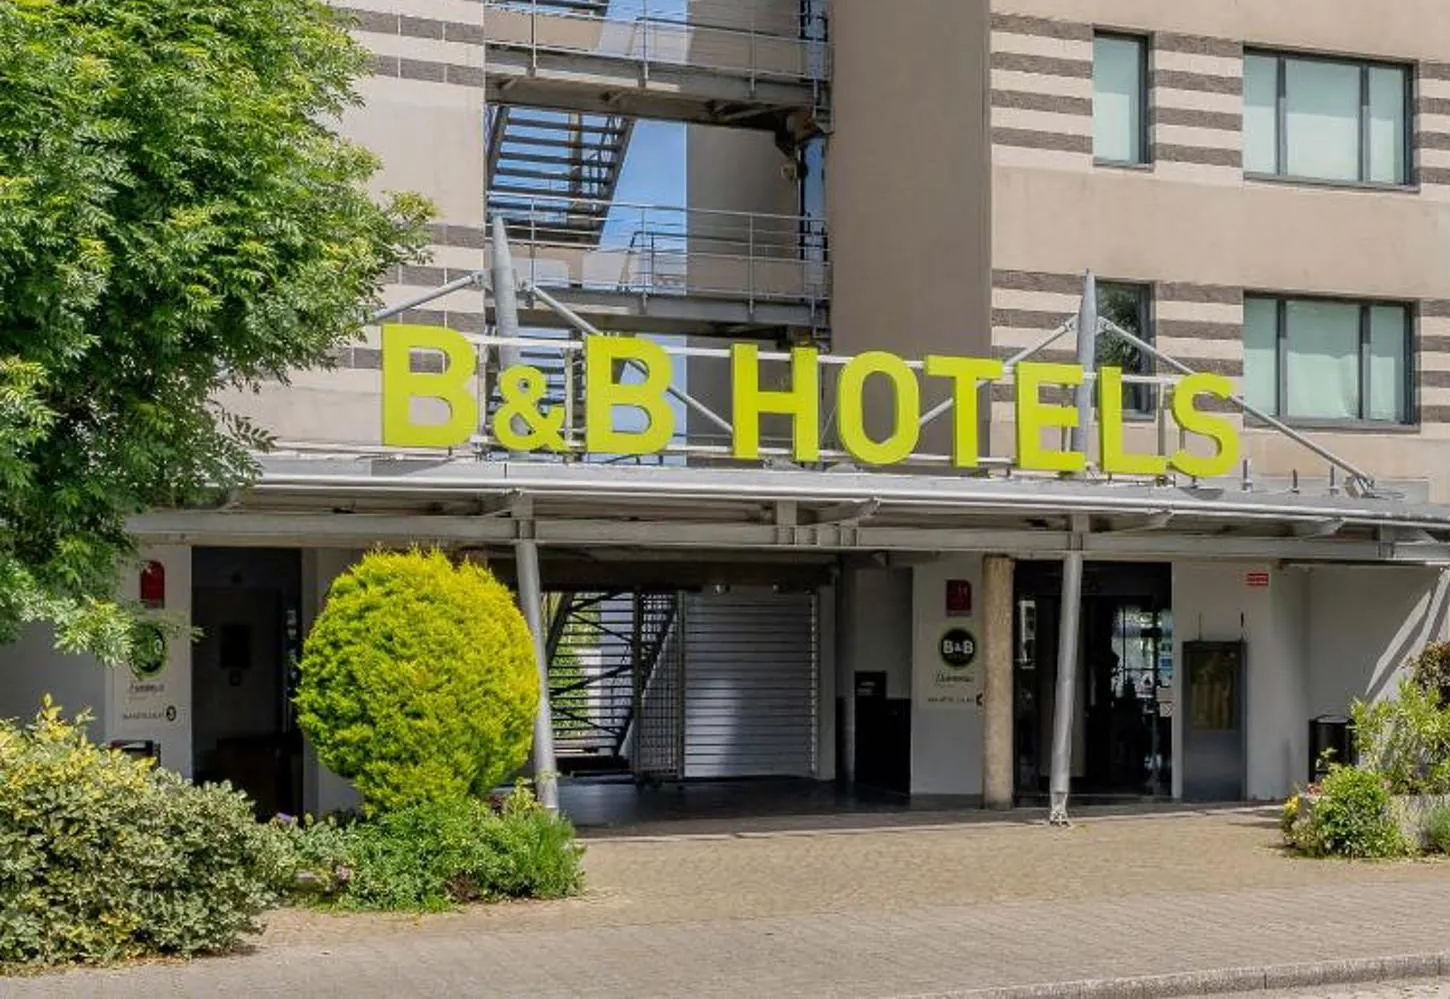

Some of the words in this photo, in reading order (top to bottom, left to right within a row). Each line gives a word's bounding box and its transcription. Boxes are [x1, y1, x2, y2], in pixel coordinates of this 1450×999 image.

[382, 322, 675, 456] B&B
[731, 342, 1241, 478] HOTELS
[943, 640, 973, 654] B&B
